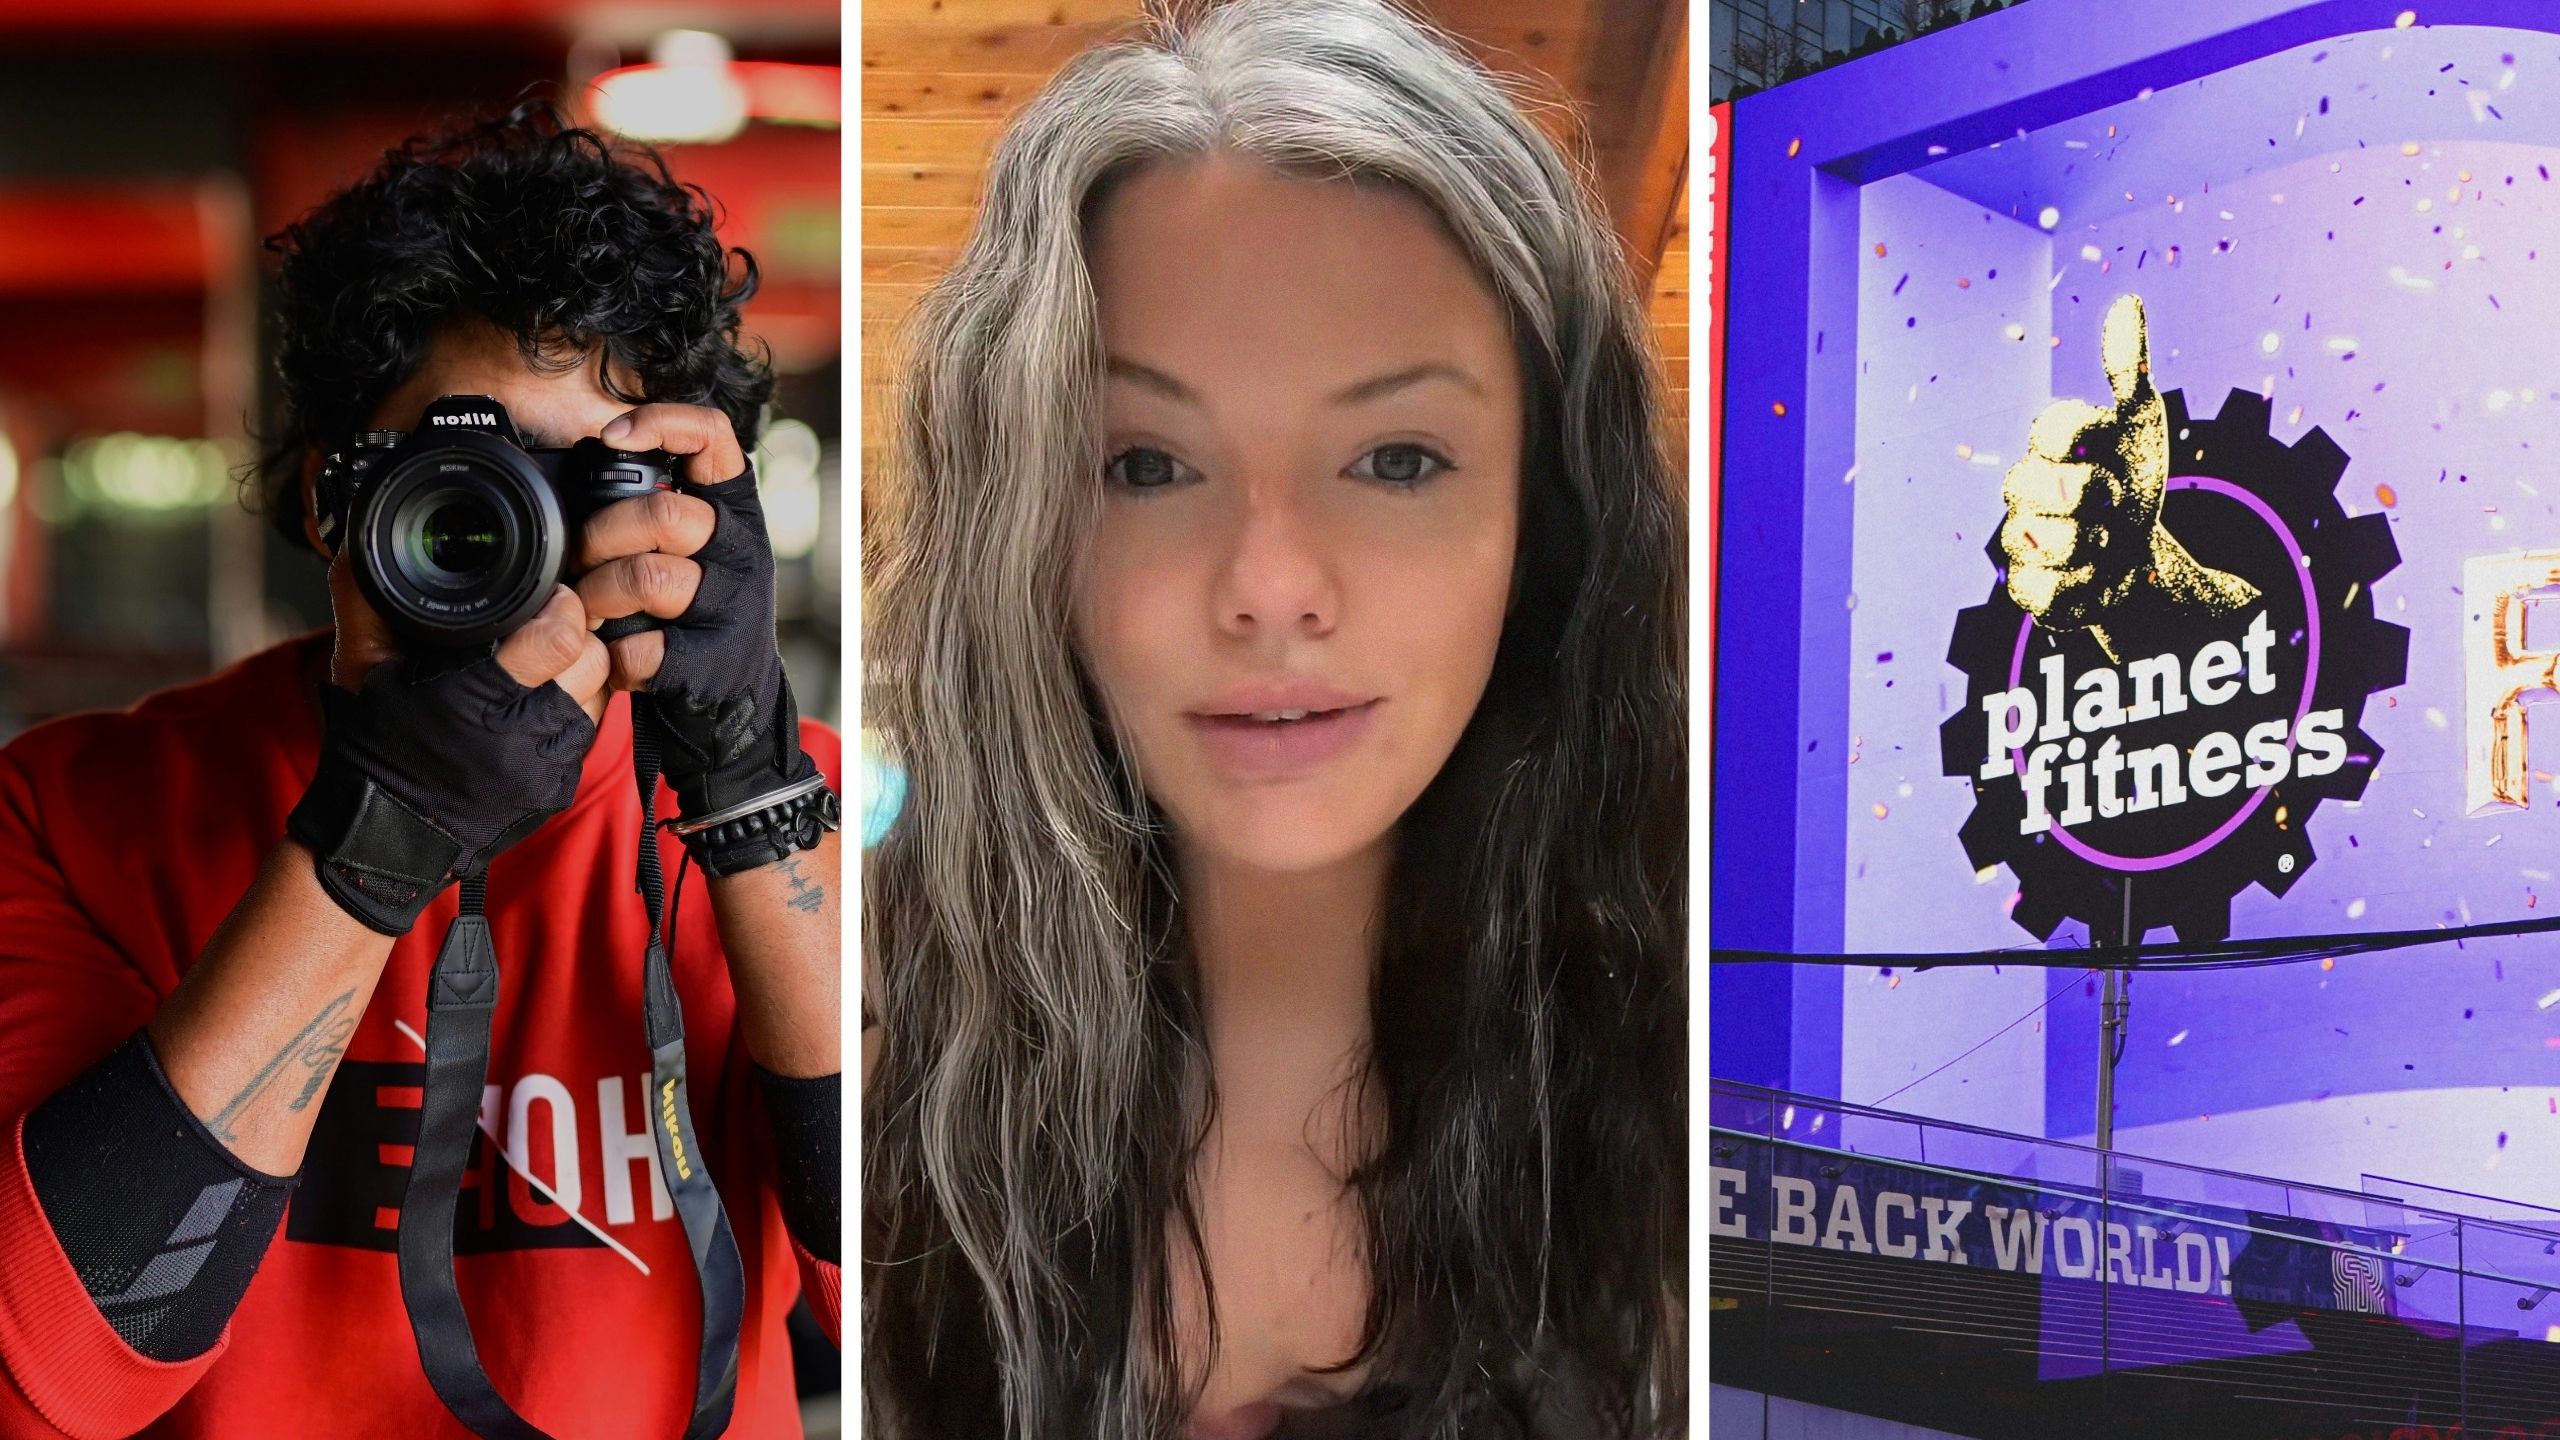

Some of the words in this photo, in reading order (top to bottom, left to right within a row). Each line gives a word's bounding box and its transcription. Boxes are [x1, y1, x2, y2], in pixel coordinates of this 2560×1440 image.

[1980, 609, 2276, 780] planet
[2020, 708, 2347, 835] fitness
[1771, 1175, 1972, 1265] BACK
[1985, 1206, 2233, 1296] WORLD!
